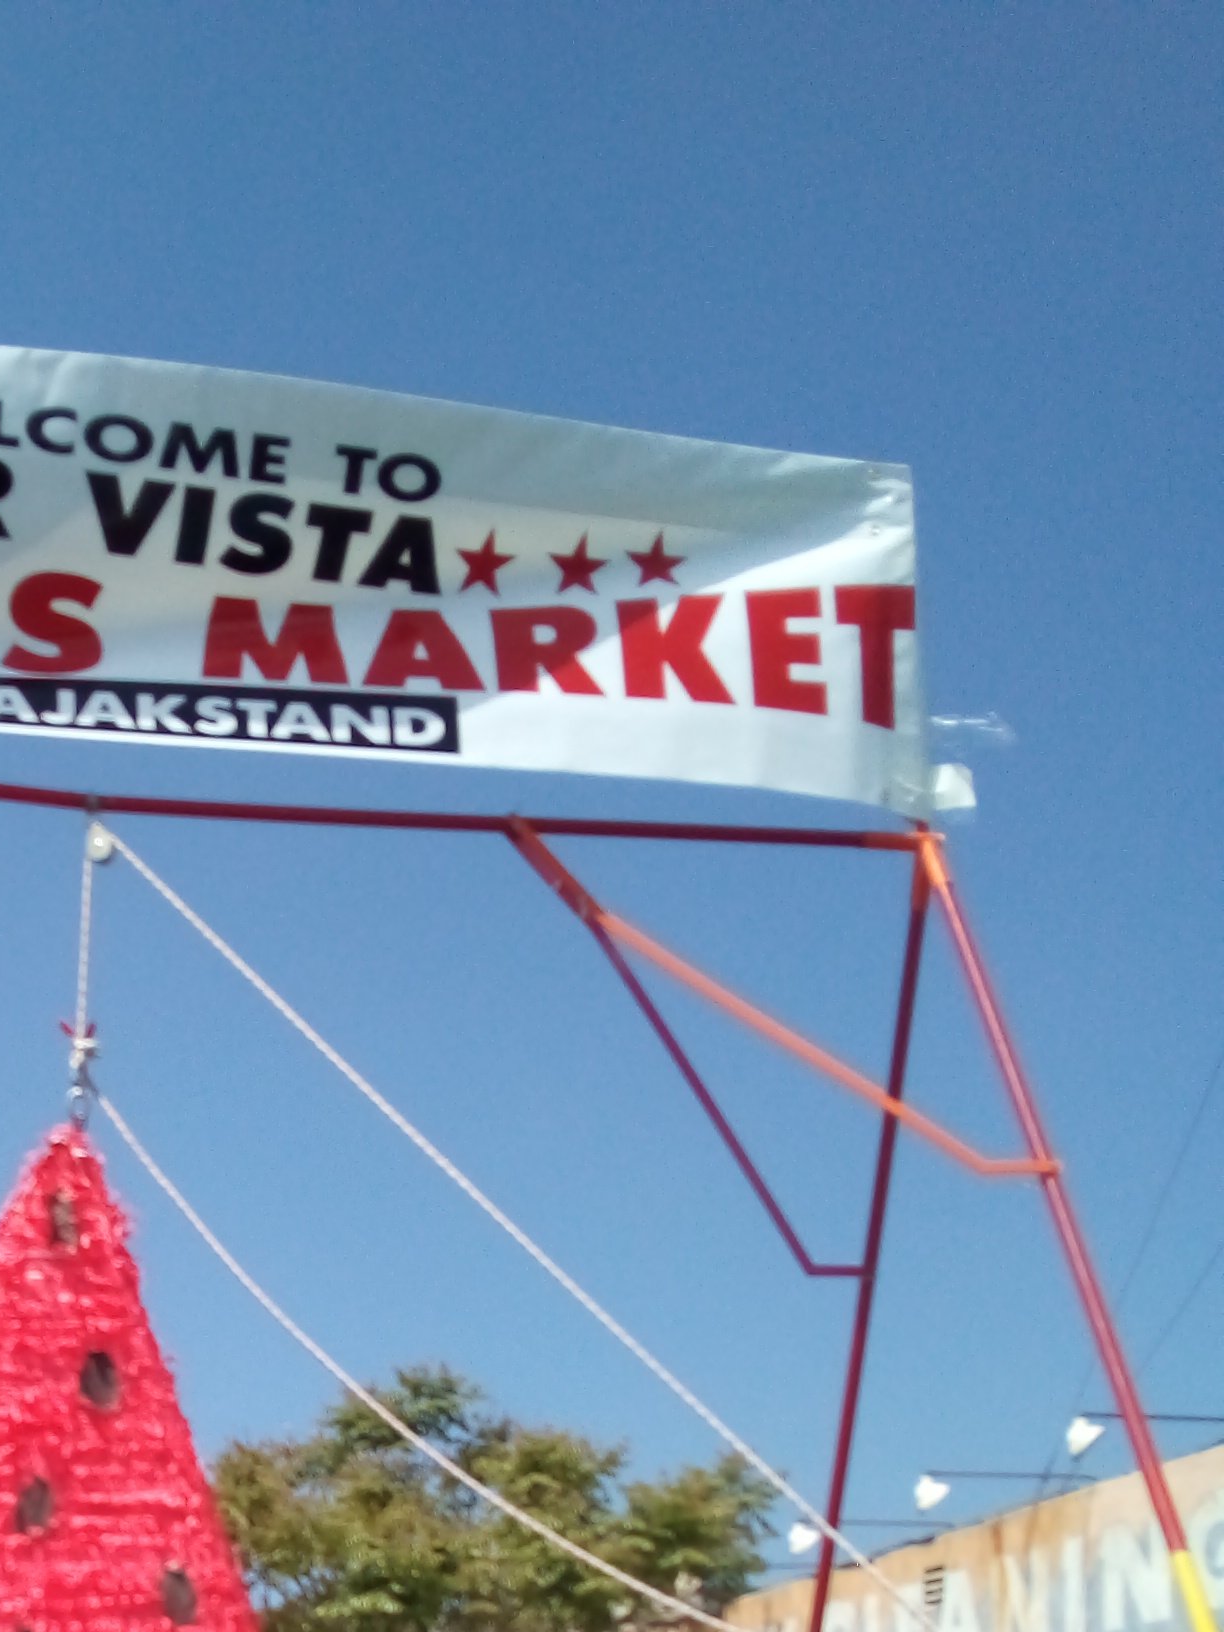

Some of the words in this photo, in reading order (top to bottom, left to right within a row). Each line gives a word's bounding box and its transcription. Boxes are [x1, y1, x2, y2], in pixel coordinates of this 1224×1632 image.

[85, 470, 442, 597] VISTA
[334, 443, 444, 504] TO
[201, 583, 916, 732] MARKET
